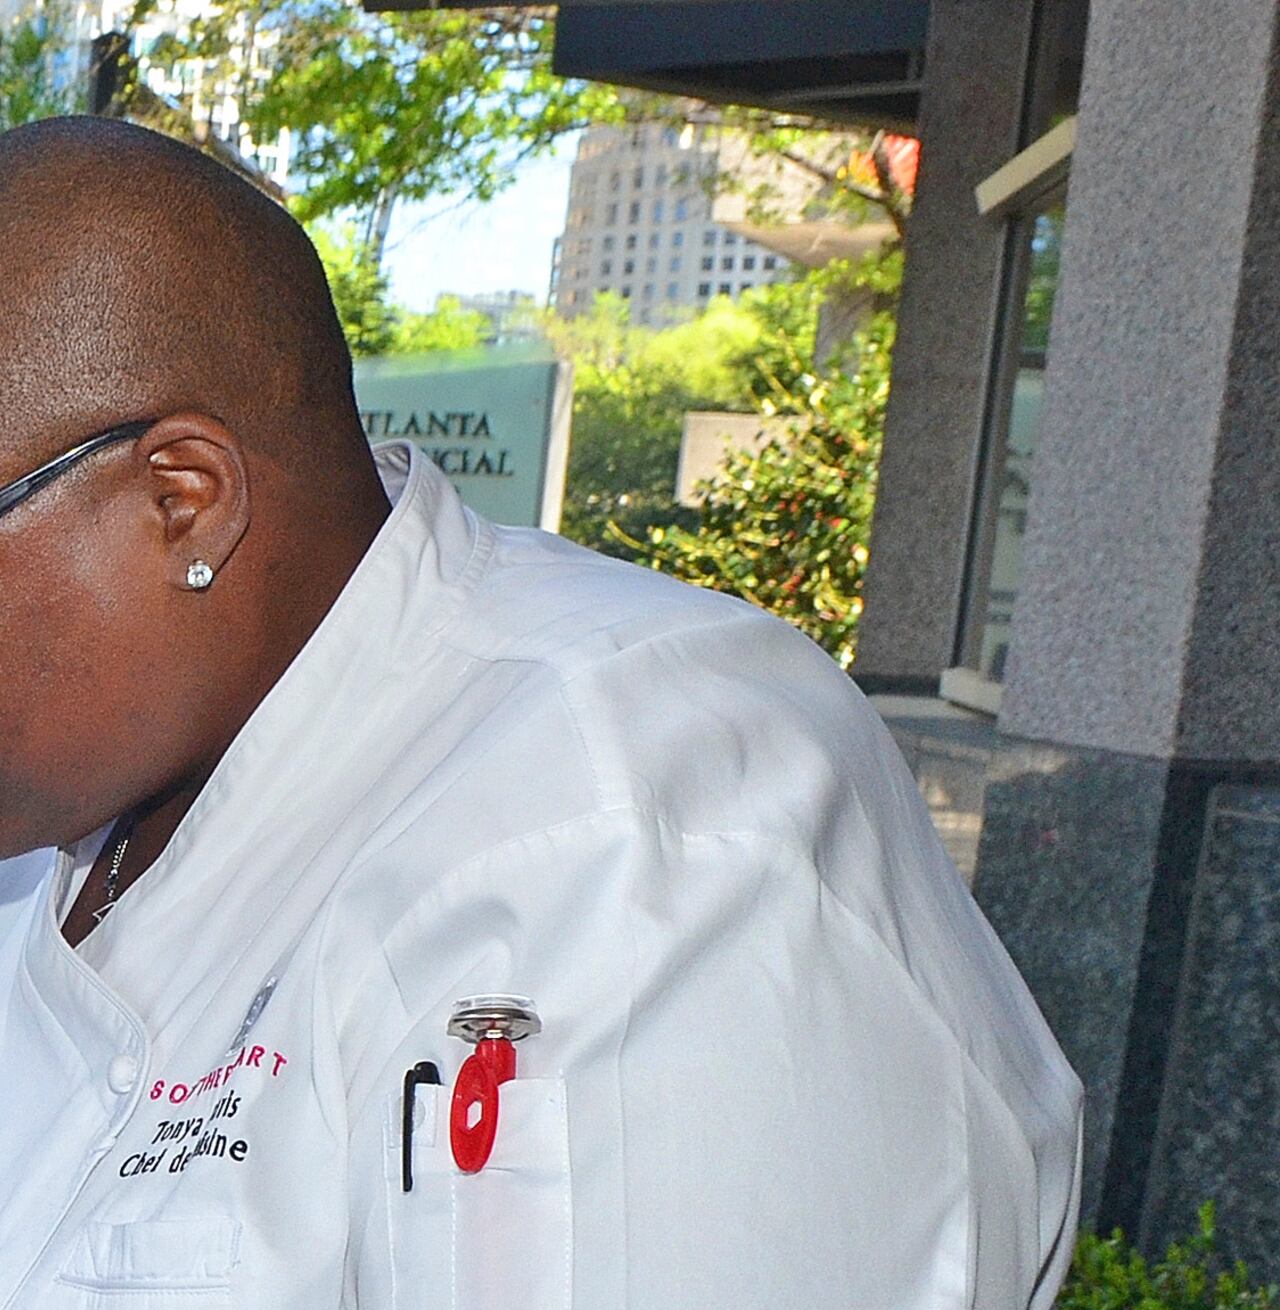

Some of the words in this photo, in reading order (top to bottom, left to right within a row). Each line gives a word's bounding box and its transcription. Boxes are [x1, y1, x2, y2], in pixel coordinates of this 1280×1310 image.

[361, 411, 493, 437] TLANTA
[151, 1117, 204, 1145] Tonya
[119, 1148, 168, 1178] Chef
